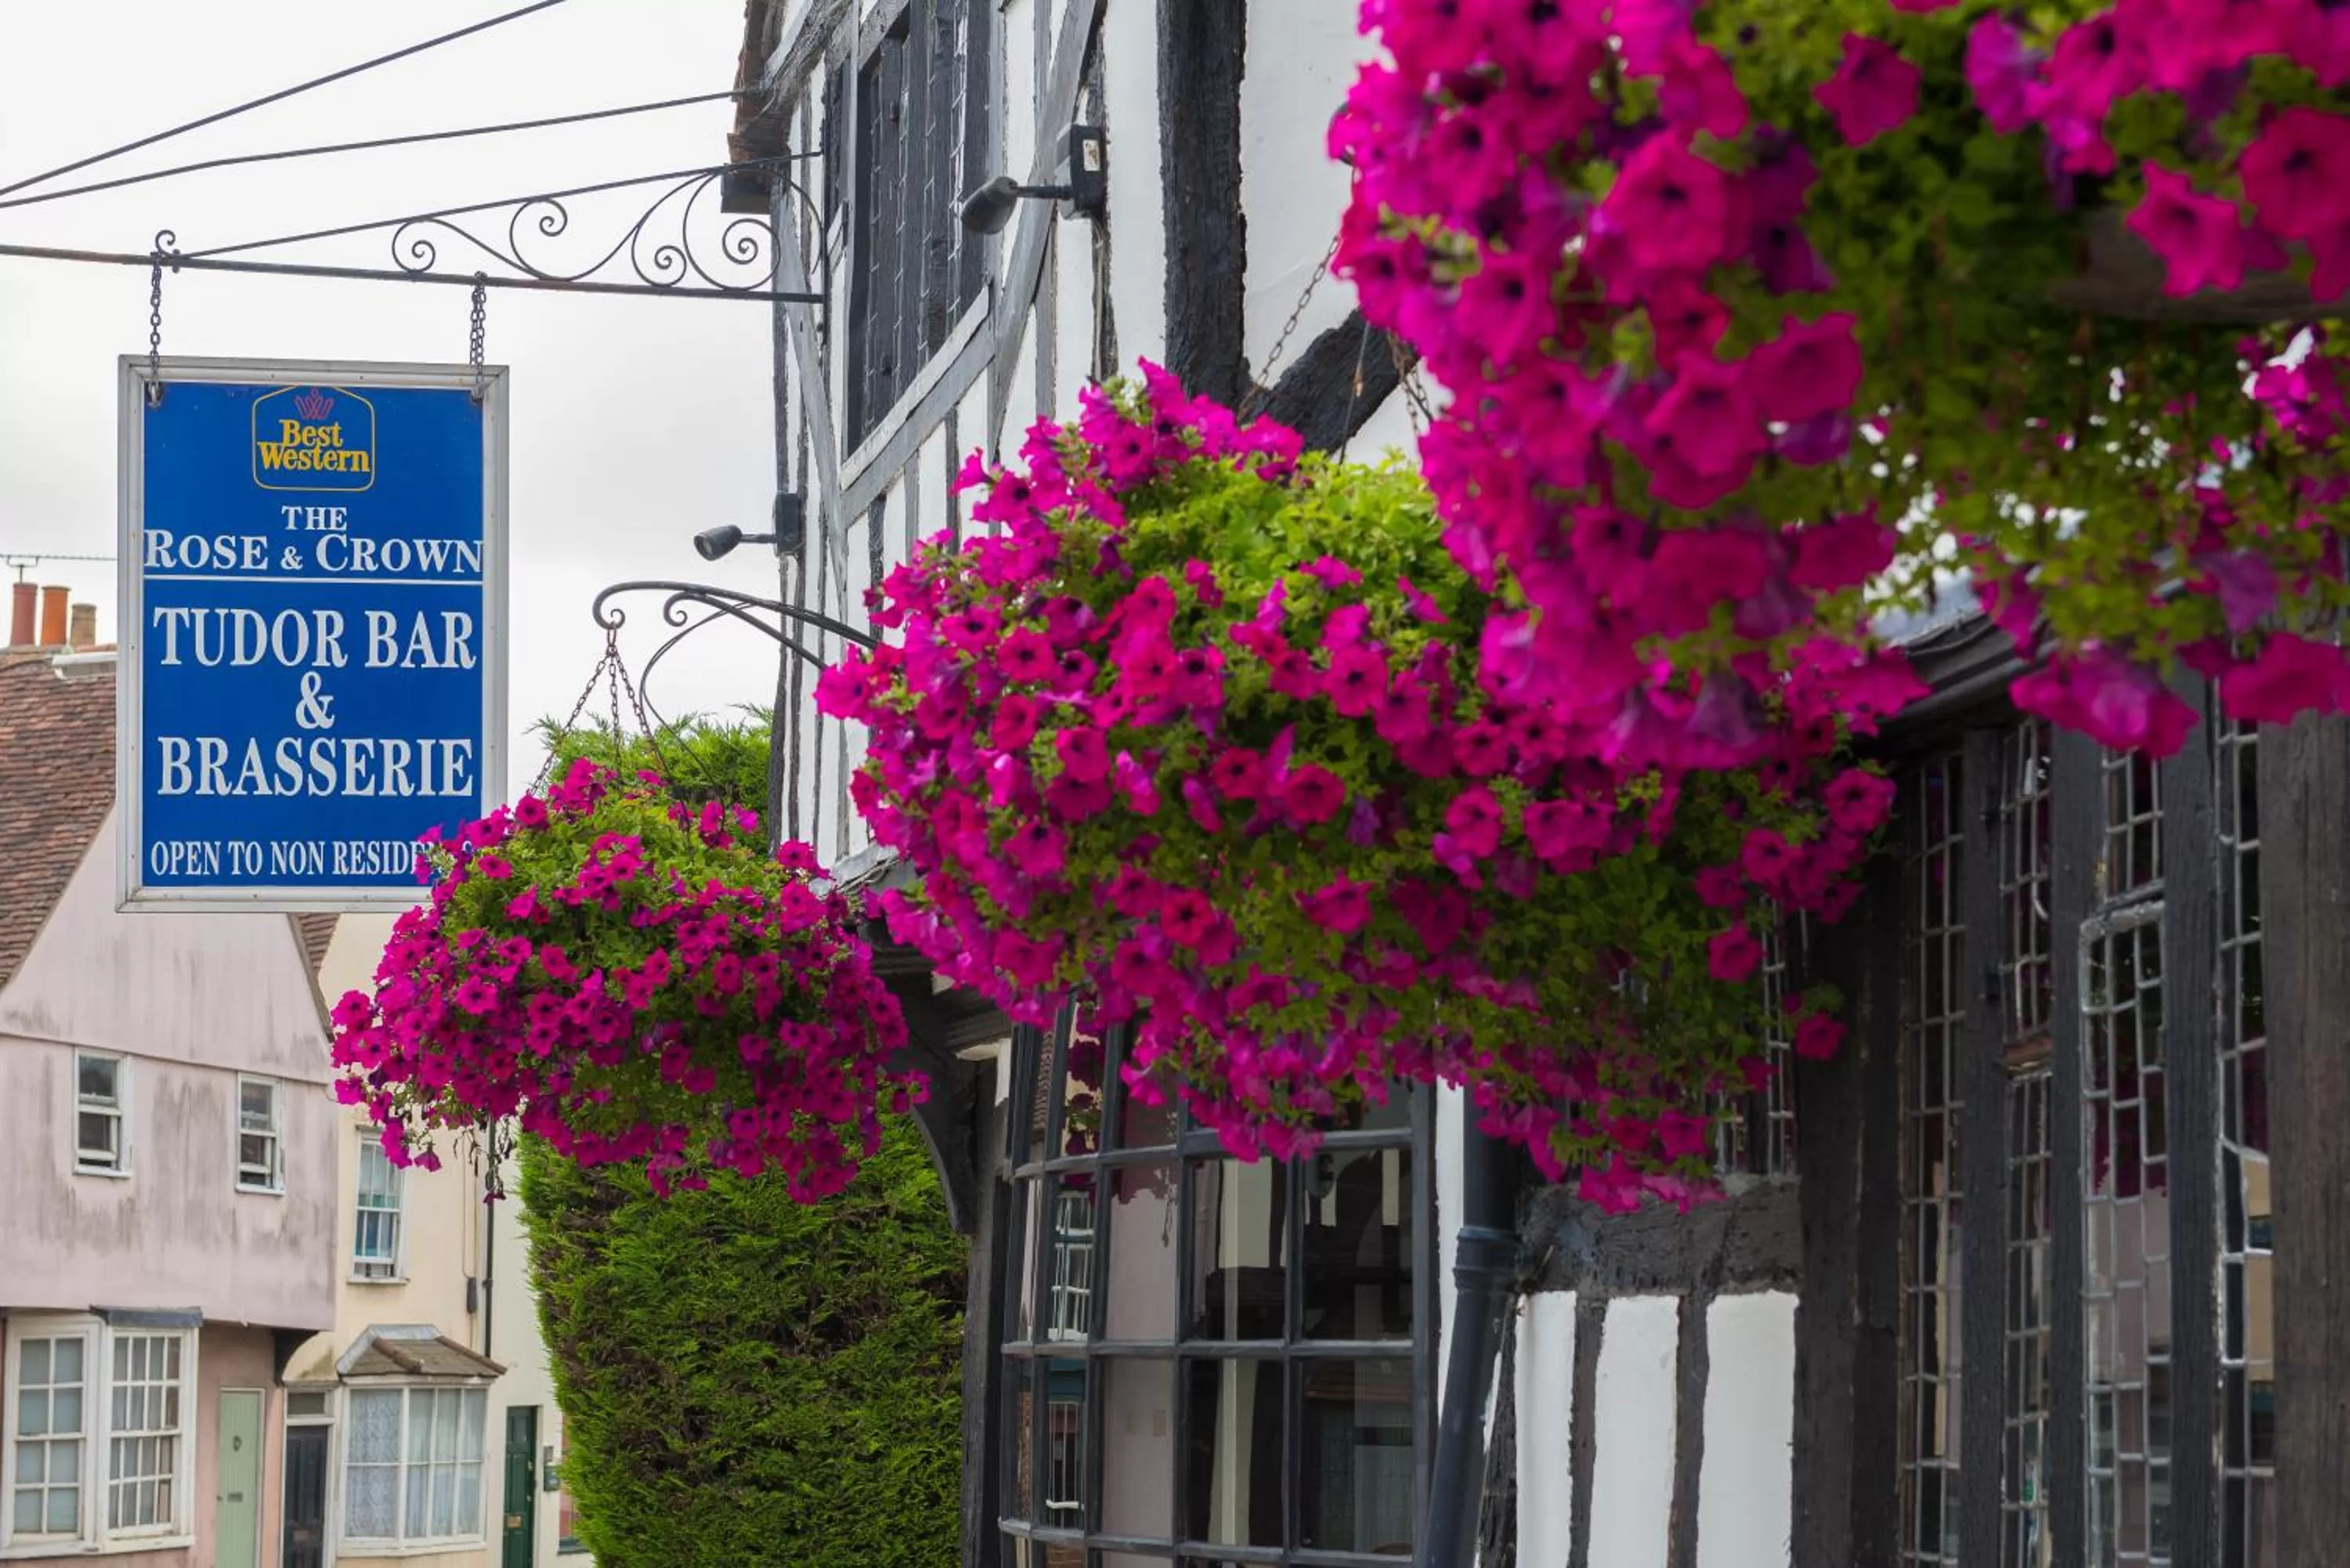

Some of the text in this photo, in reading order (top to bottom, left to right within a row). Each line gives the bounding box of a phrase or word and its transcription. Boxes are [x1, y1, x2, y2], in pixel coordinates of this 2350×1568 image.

[279, 419, 344, 448] Best
[257, 442, 371, 472] Western
[281, 506, 347, 531] THE
[280, 547, 303, 570] &
[154, 607, 477, 669] TUDOR BAR
[295, 671, 335, 729] &
[157, 736, 473, 797] BRASSERIE
[151, 840, 221, 876] OPEN
[228, 840, 263, 876] TO
[270, 841, 325, 875] NON
